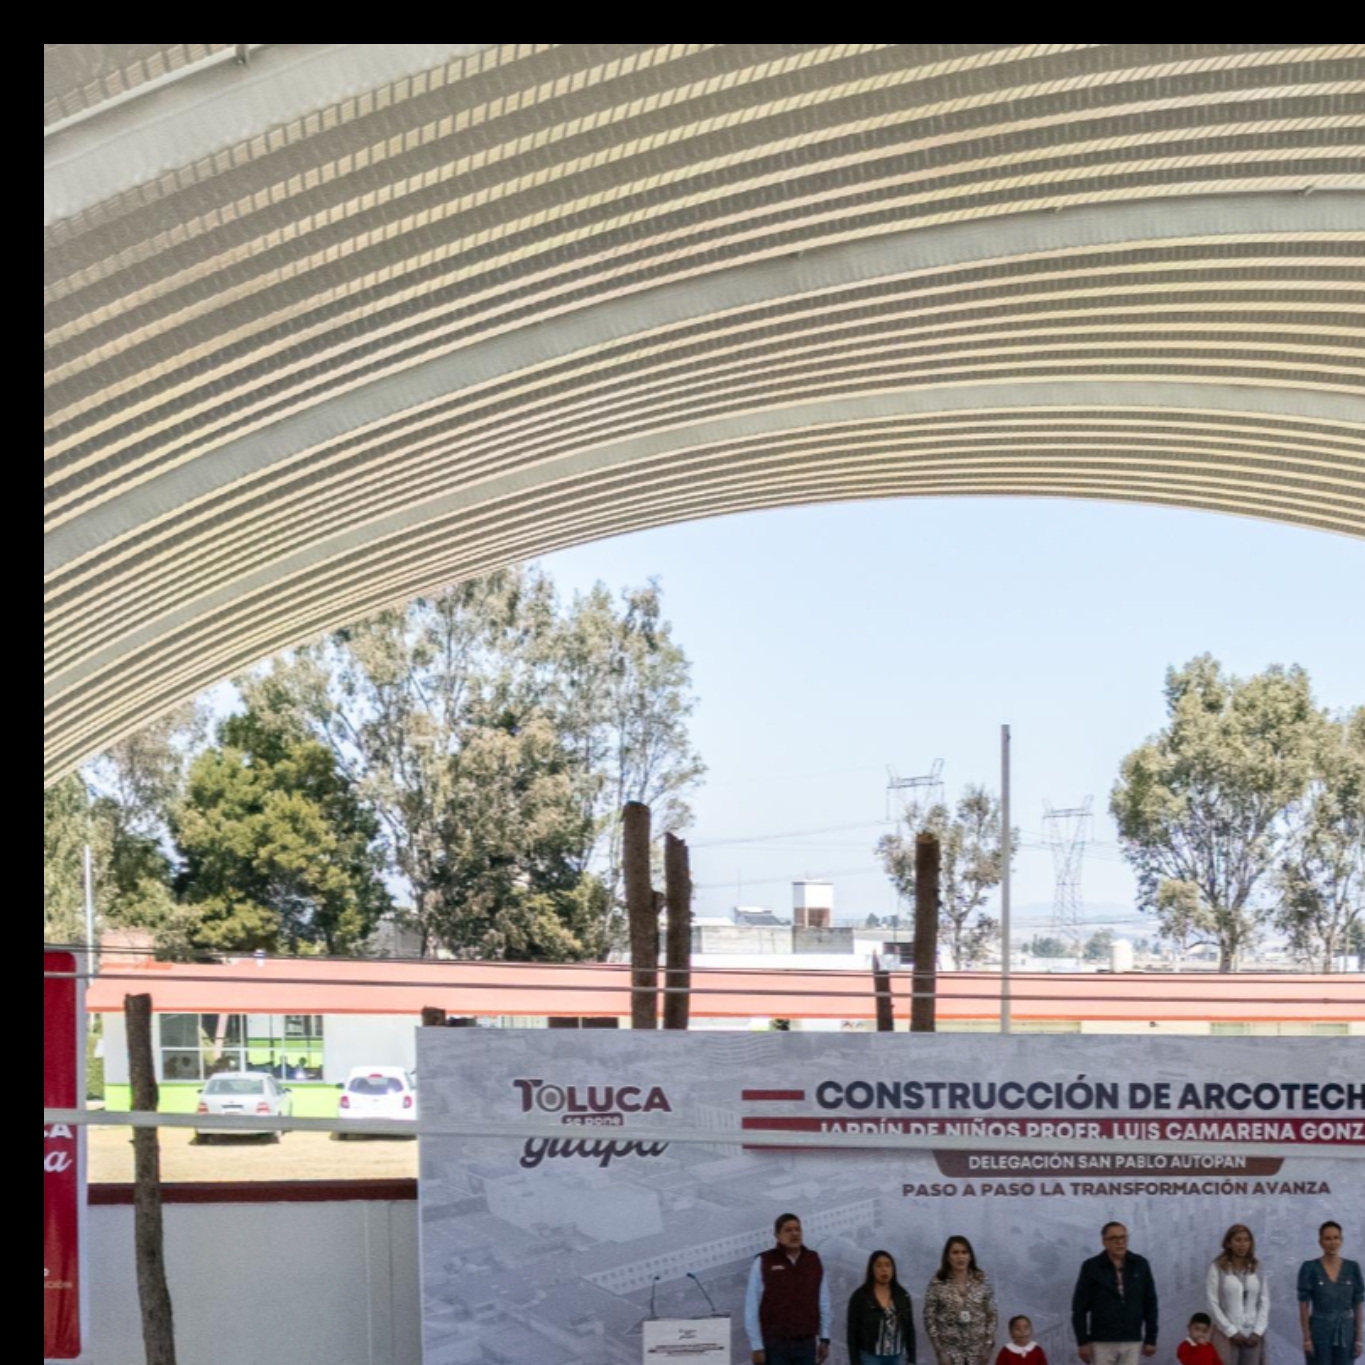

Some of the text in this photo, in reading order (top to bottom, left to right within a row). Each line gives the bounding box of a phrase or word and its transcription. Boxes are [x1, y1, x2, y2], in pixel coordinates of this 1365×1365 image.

[513, 1079, 672, 1113] TOLUCA
[816, 1074, 1119, 1111] CONSTRUCCIÓN
[1129, 1082, 1171, 1110] DE
[1113, 1122, 1161, 1140] LUIS
[1165, 1122, 1296, 1141] CAMARENA
[968, 1152, 1247, 1170] DELEGACIÓN SAN PABLO AUTOPAN
[903, 1178, 1331, 1197] PASO A PASO LA TRANSFORMACIÓN AVANZA
